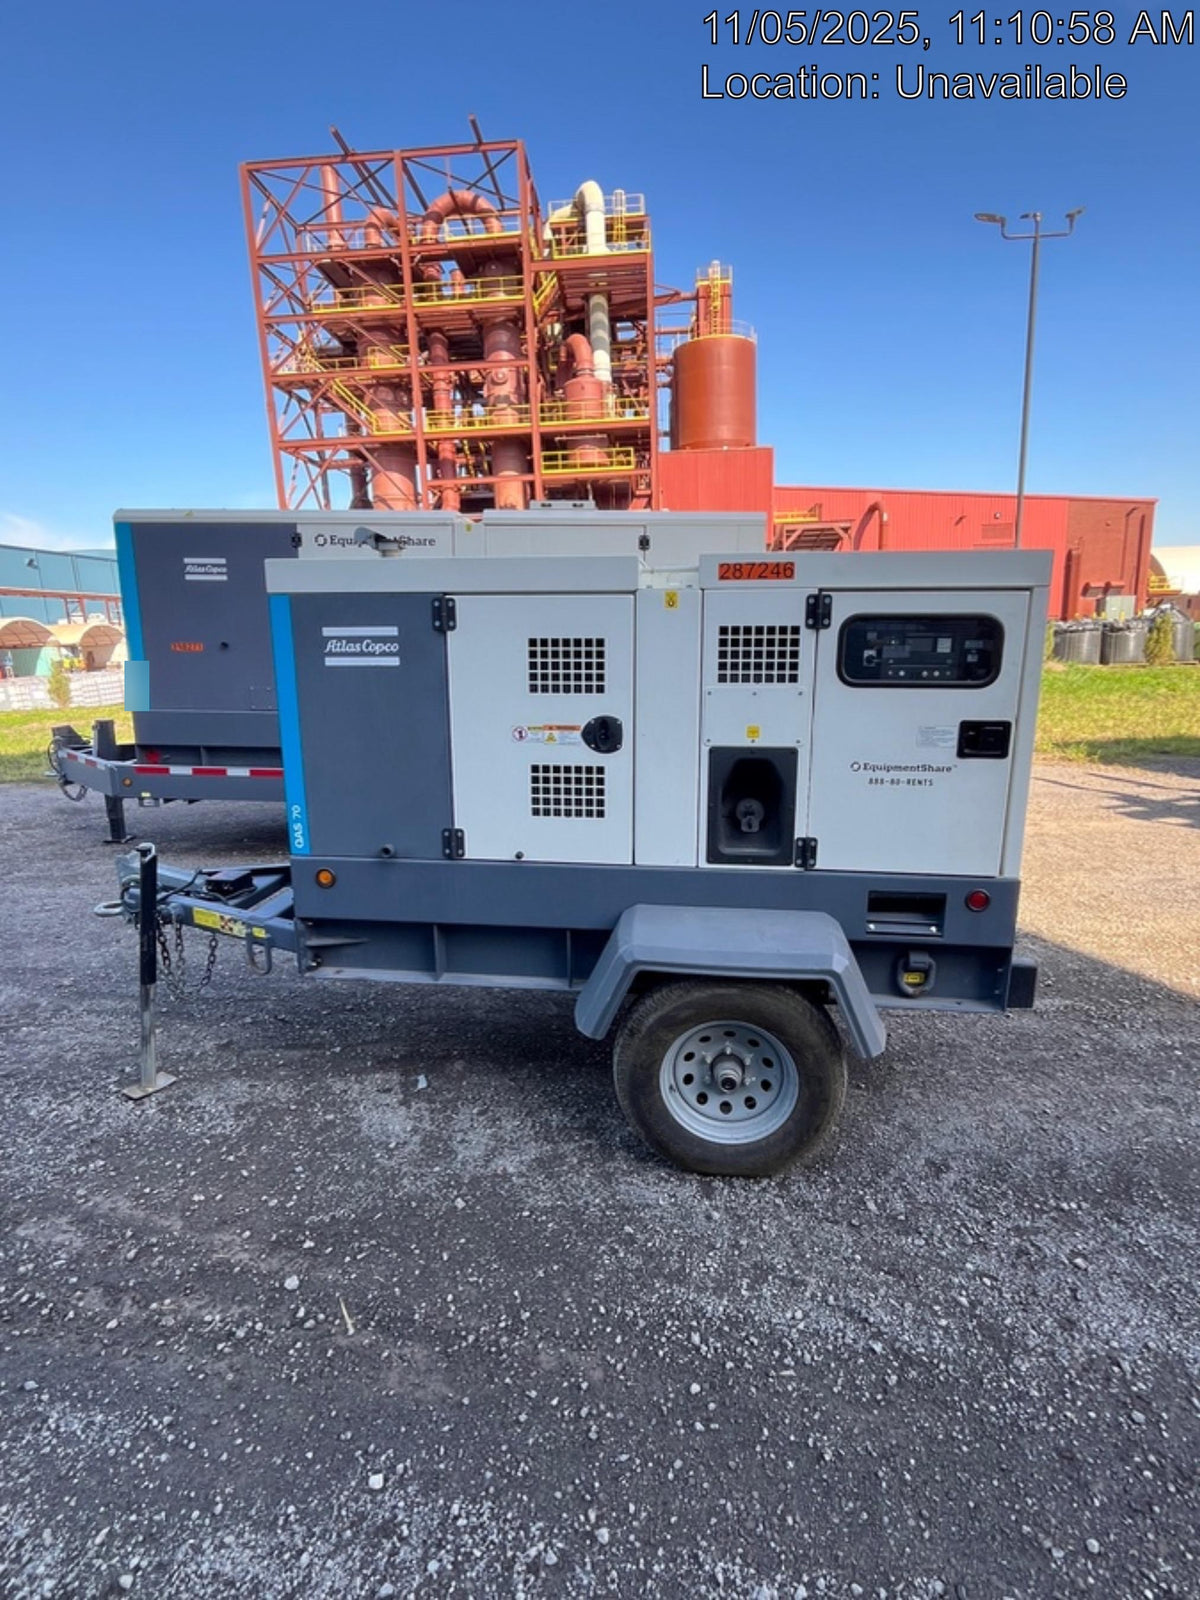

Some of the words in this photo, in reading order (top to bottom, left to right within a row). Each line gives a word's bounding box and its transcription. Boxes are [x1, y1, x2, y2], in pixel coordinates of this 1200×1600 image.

[718, 561, 795, 580] 287246
[291, 804, 302, 820] 70
[292, 822, 305, 849] QAS
